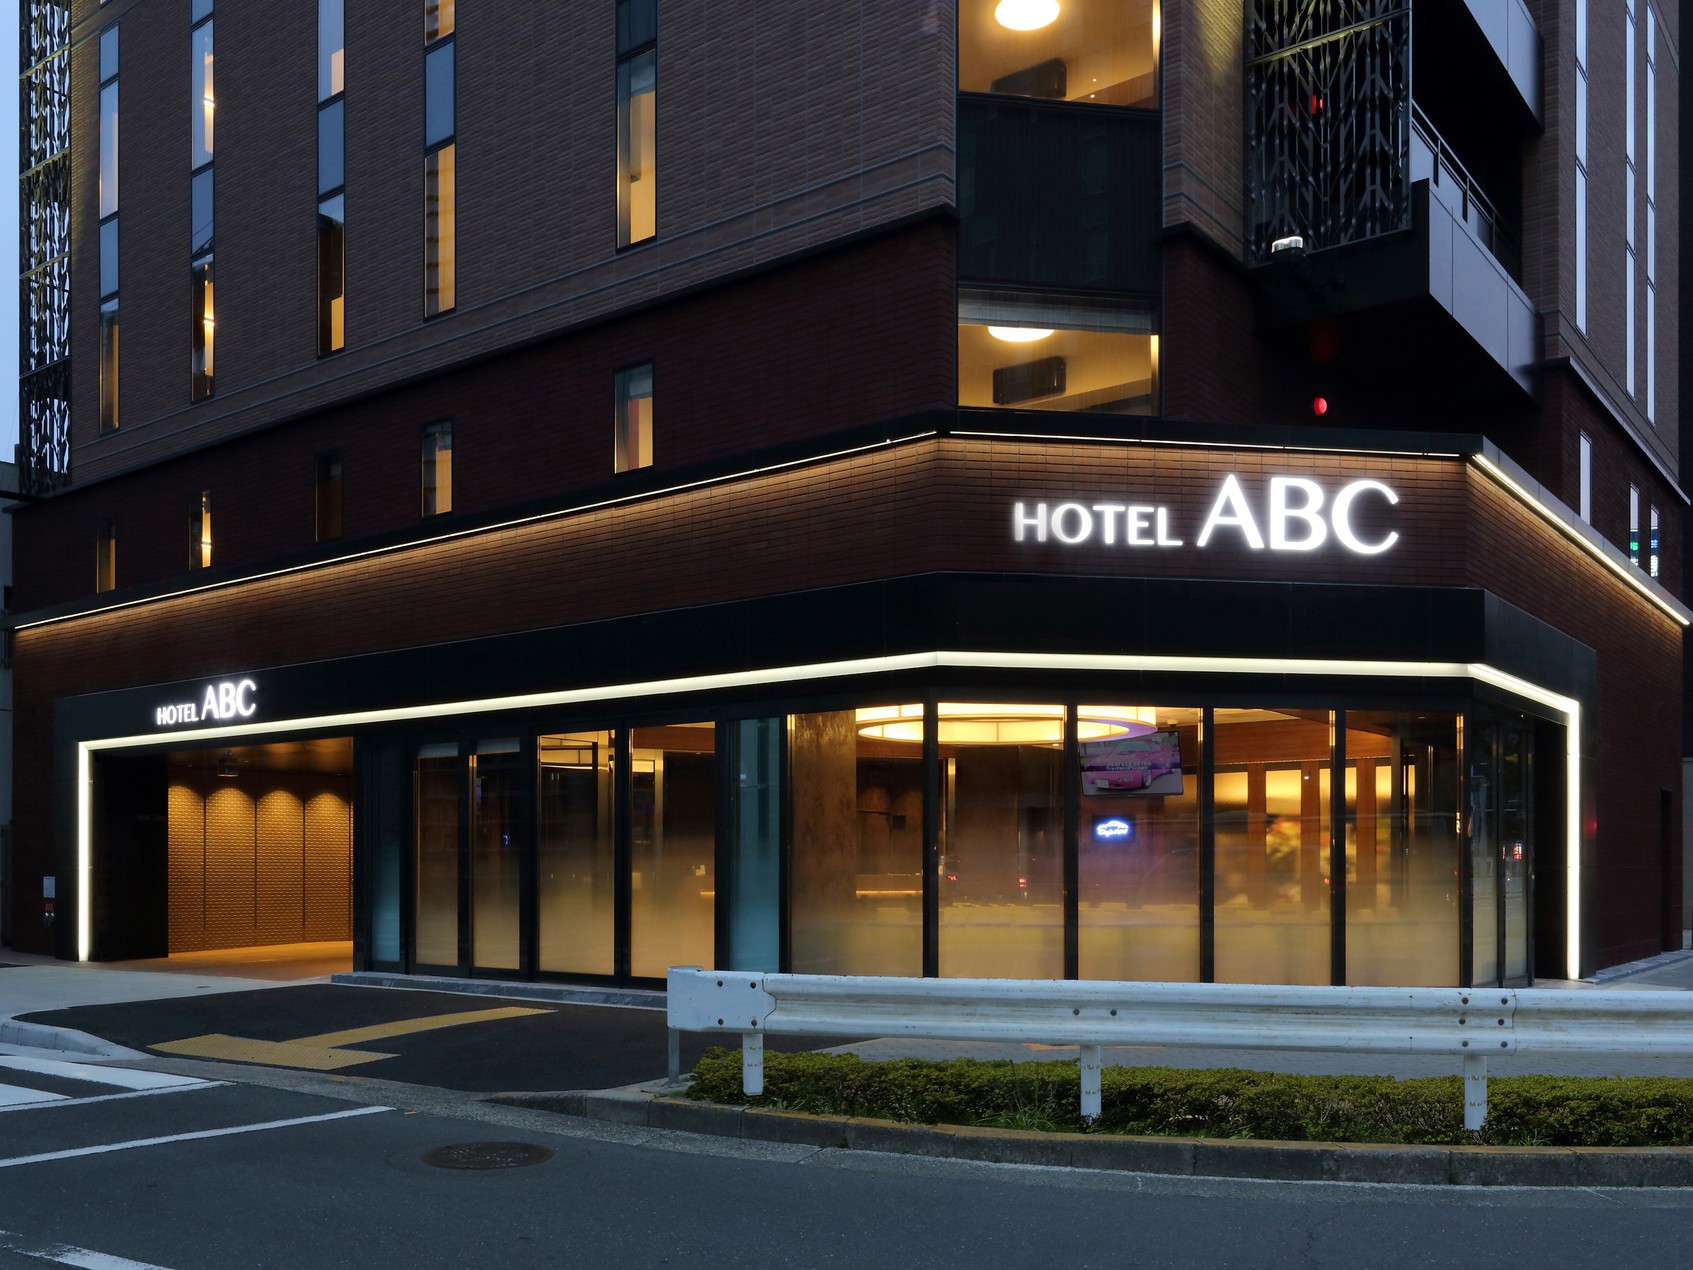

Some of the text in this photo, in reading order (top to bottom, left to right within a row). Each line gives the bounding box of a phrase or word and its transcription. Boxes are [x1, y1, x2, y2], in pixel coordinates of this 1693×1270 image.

[1014, 473, 1399, 556] HOTEL ABC
[156, 679, 257, 726] HOTEL ABC
